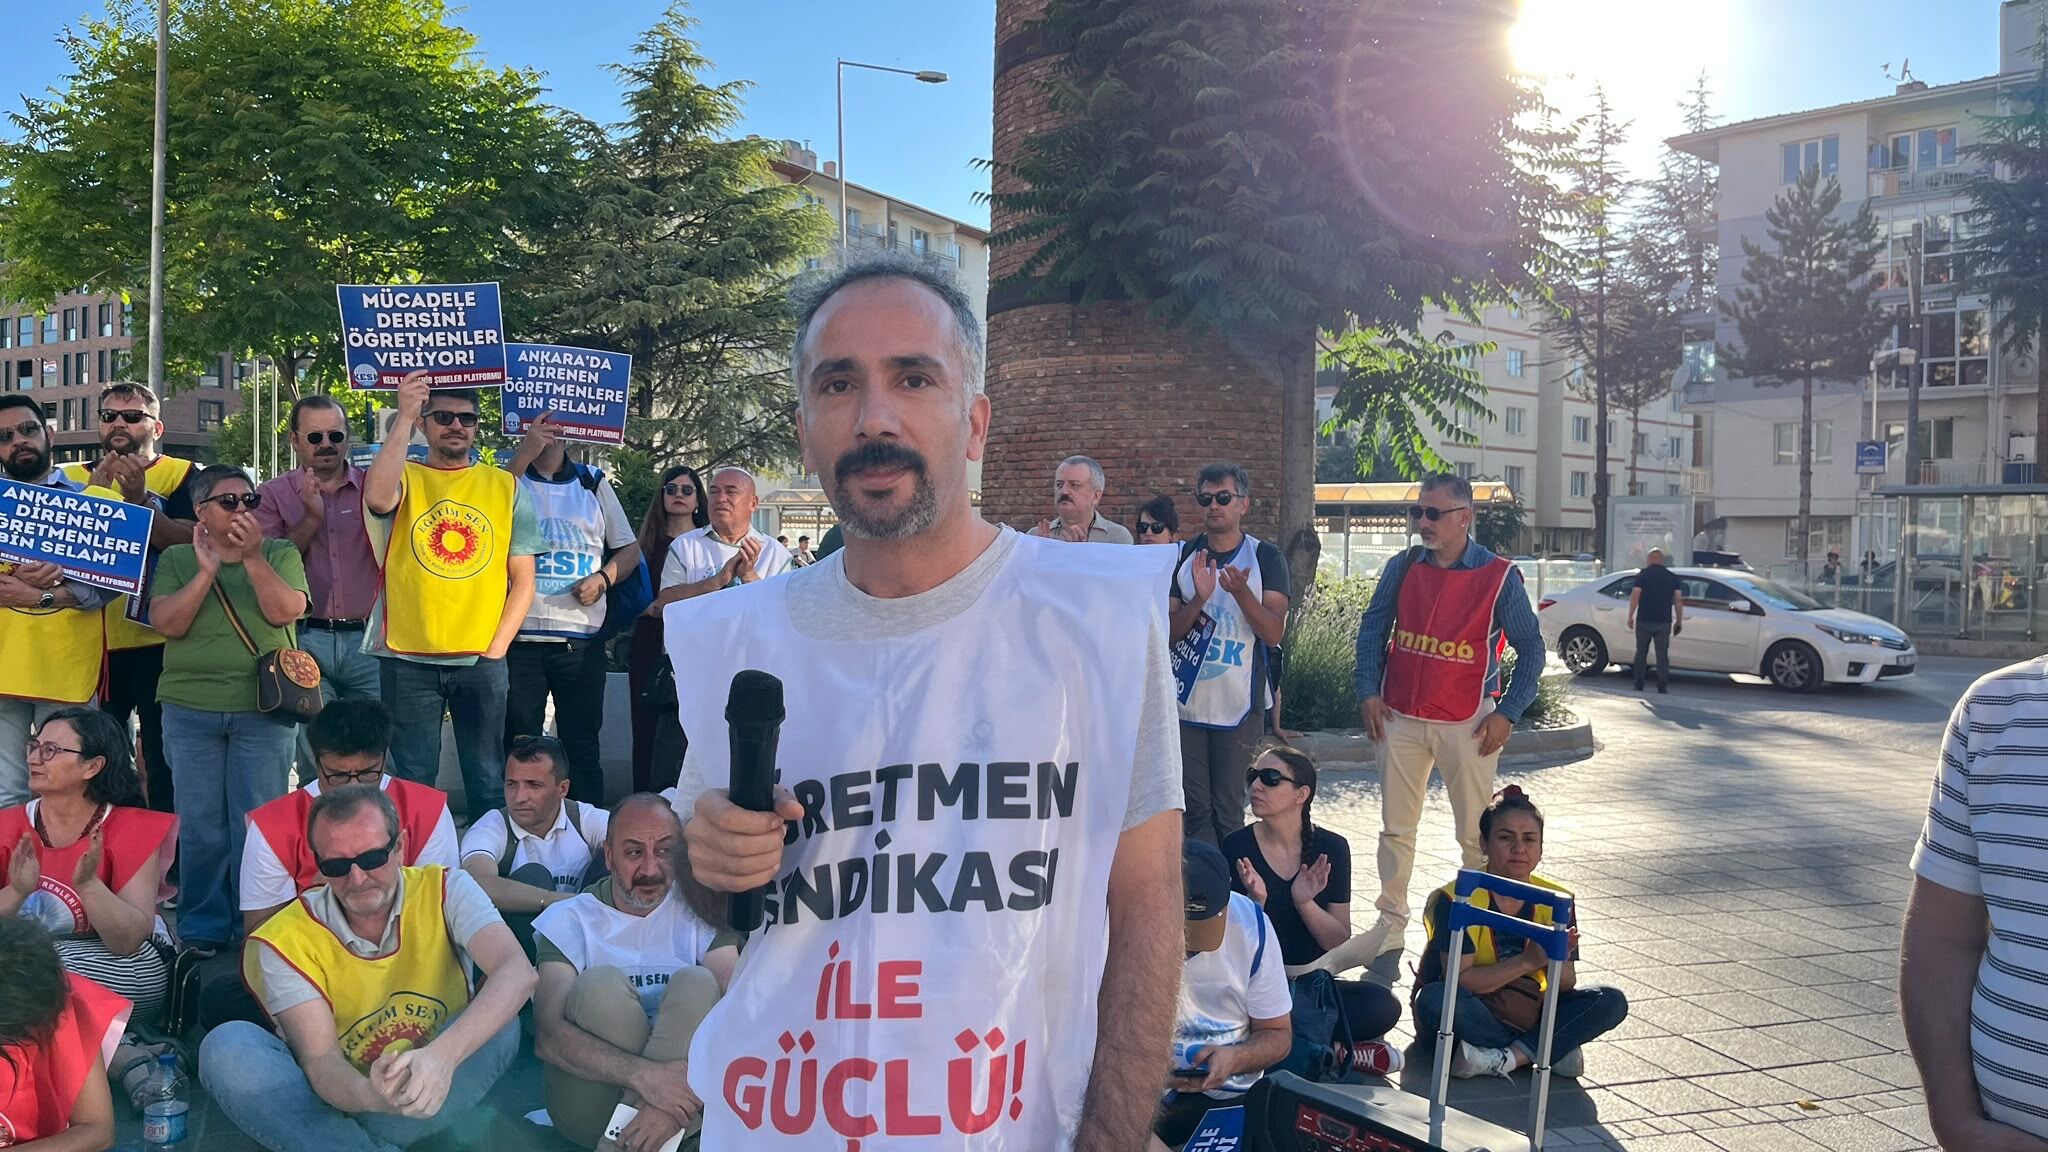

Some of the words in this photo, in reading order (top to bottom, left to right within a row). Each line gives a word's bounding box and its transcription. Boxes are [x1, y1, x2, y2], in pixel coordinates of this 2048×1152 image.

[362, 288, 476, 309] MÜCADELE
[376, 307, 466, 328] DERSİNİ
[349, 327, 499, 348] ÖĞRETMENLER
[374, 347, 475, 367] VERİYOR!
[518, 350, 612, 371] ANKARA'DA
[464, 371, 501, 382] PLATFORMU
[528, 363, 599, 384] DİRENEN
[504, 377, 624, 403] ÖĞRETMENLERE
[518, 393, 544, 409] BİN
[548, 397, 606, 416] SELAM!
[2, 486, 128, 521] ANKARA'DA
[16, 502, 110, 533] DİRENEN
[0, 512, 141, 555] ĞRETMENLERE
[40, 541, 117, 566] SELAM!
[535, 550, 594, 577] ESK
[774, 762, 1080, 846] RETMEN
[646, 973, 670, 986] SEN
[815, 939, 923, 1021] İLE
[722, 1026, 1027, 1152] GÜÇLÜ!
